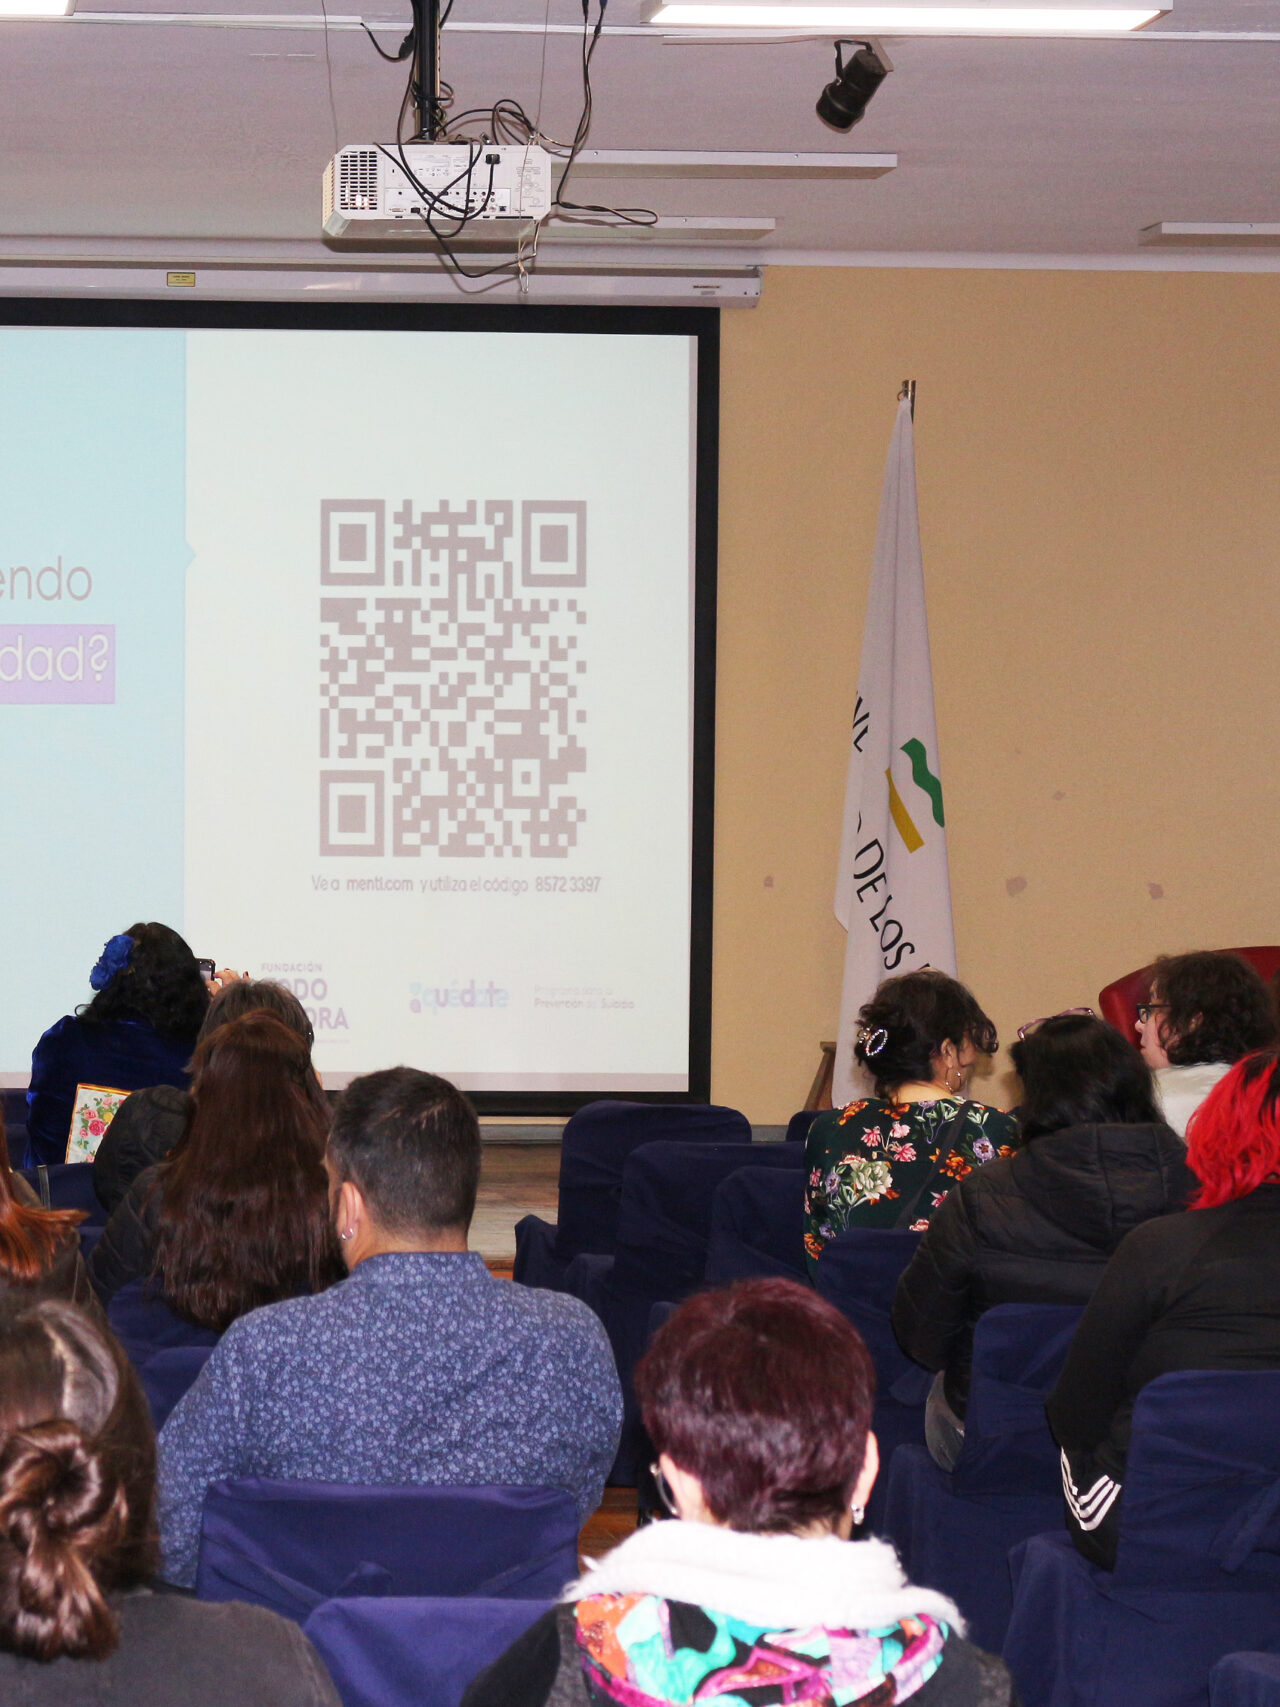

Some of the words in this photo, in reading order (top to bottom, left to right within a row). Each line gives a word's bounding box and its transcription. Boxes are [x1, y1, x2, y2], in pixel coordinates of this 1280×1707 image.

[430, 875, 467, 892] utiliza
[483, 875, 529, 896] código
[536, 876, 567, 892] 8572
[569, 876, 602, 892] 3397
[261, 961, 323, 973] FUNDACIÓN
